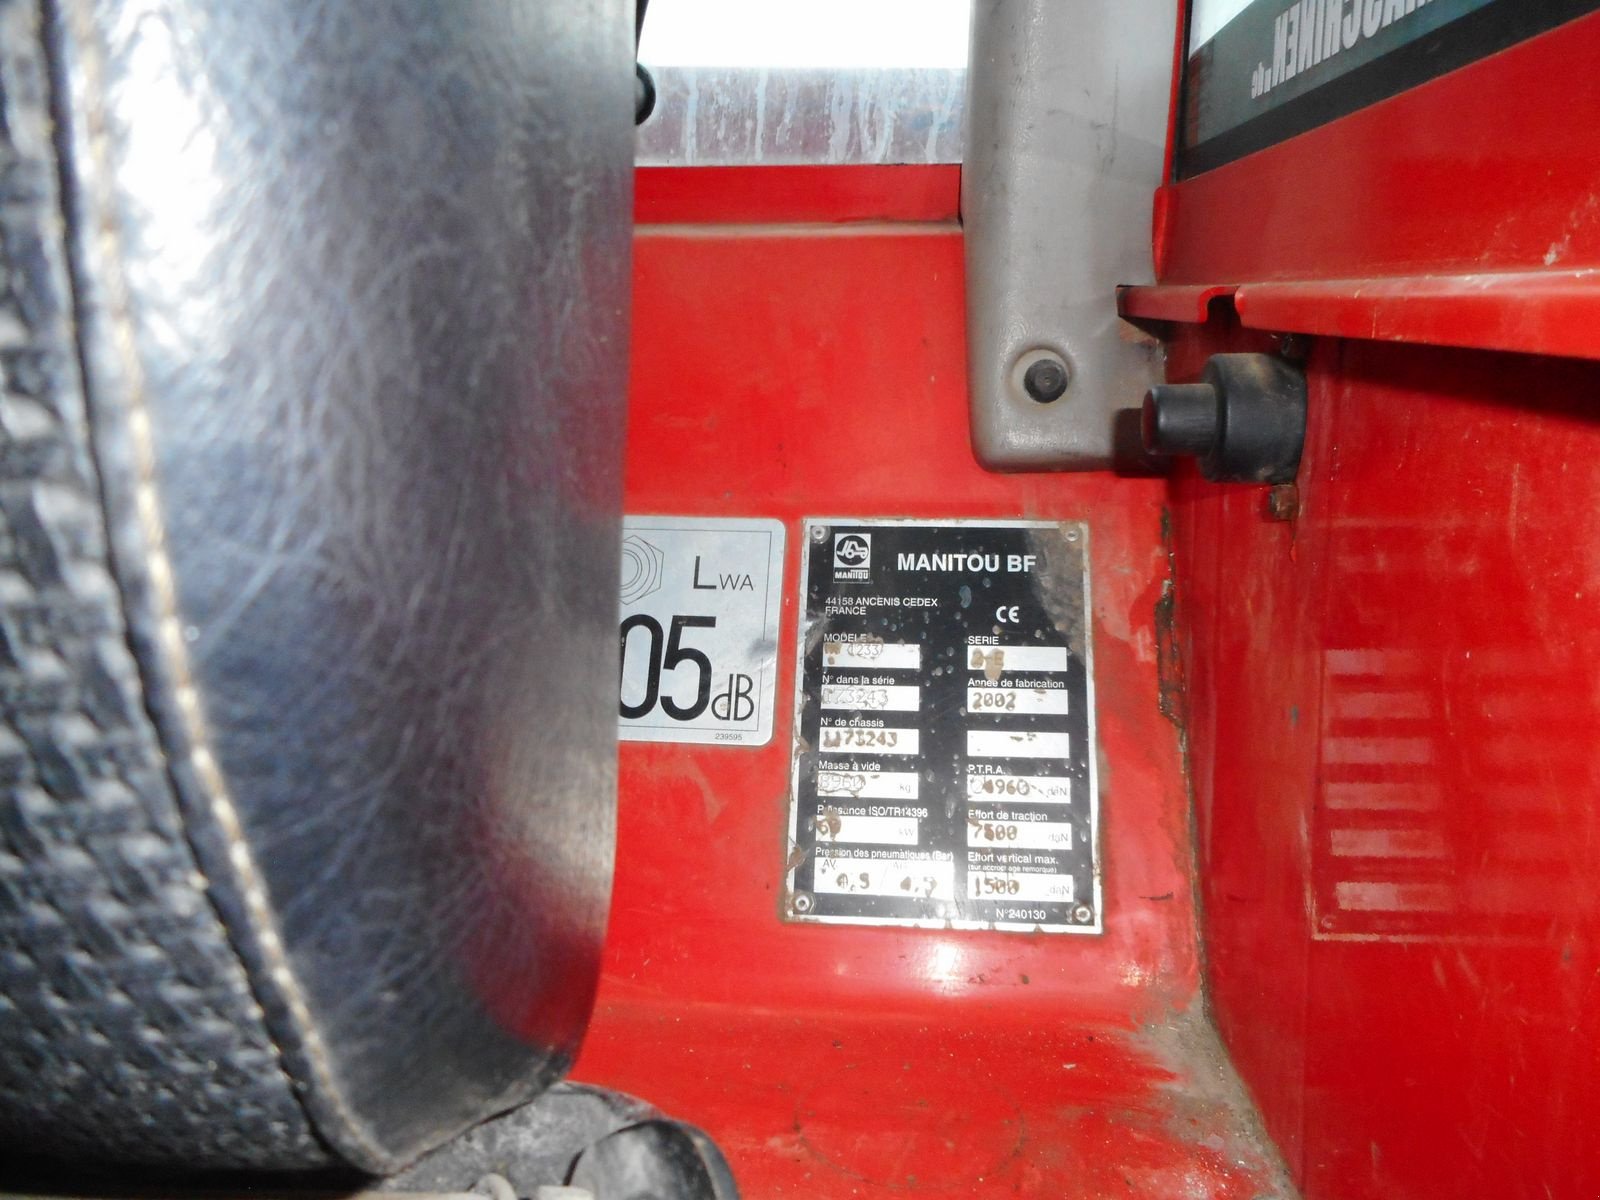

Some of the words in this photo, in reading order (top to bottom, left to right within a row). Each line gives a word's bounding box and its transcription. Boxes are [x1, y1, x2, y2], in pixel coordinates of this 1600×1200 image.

[898, 553, 1000, 572] MANITOU
[1007, 555, 1036, 572] BF
[825, 597, 853, 606] 44158
[855, 597, 900, 607] ANCENIS
[903, 598, 938, 607] CEDEX
[825, 607, 867, 615] FRANCE
[996, 606, 1020, 623] CE
[968, 635, 999, 645] SERIE
[836, 675, 859, 684] dans
[861, 675, 870, 685] la
[872, 675, 895, 685] série
[1001, 679, 1012, 687] de
[1015, 678, 1065, 688] fabrication
[973, 691, 1016, 711] 2002
[835, 717, 846, 726] de
[849, 717, 884, 727] chassis
[818, 760, 850, 770] Masse
[861, 761, 881, 771] vide
[996, 811, 1009, 820] de
[1012, 811, 1048, 822] traction
[854, 847, 869, 857] des
